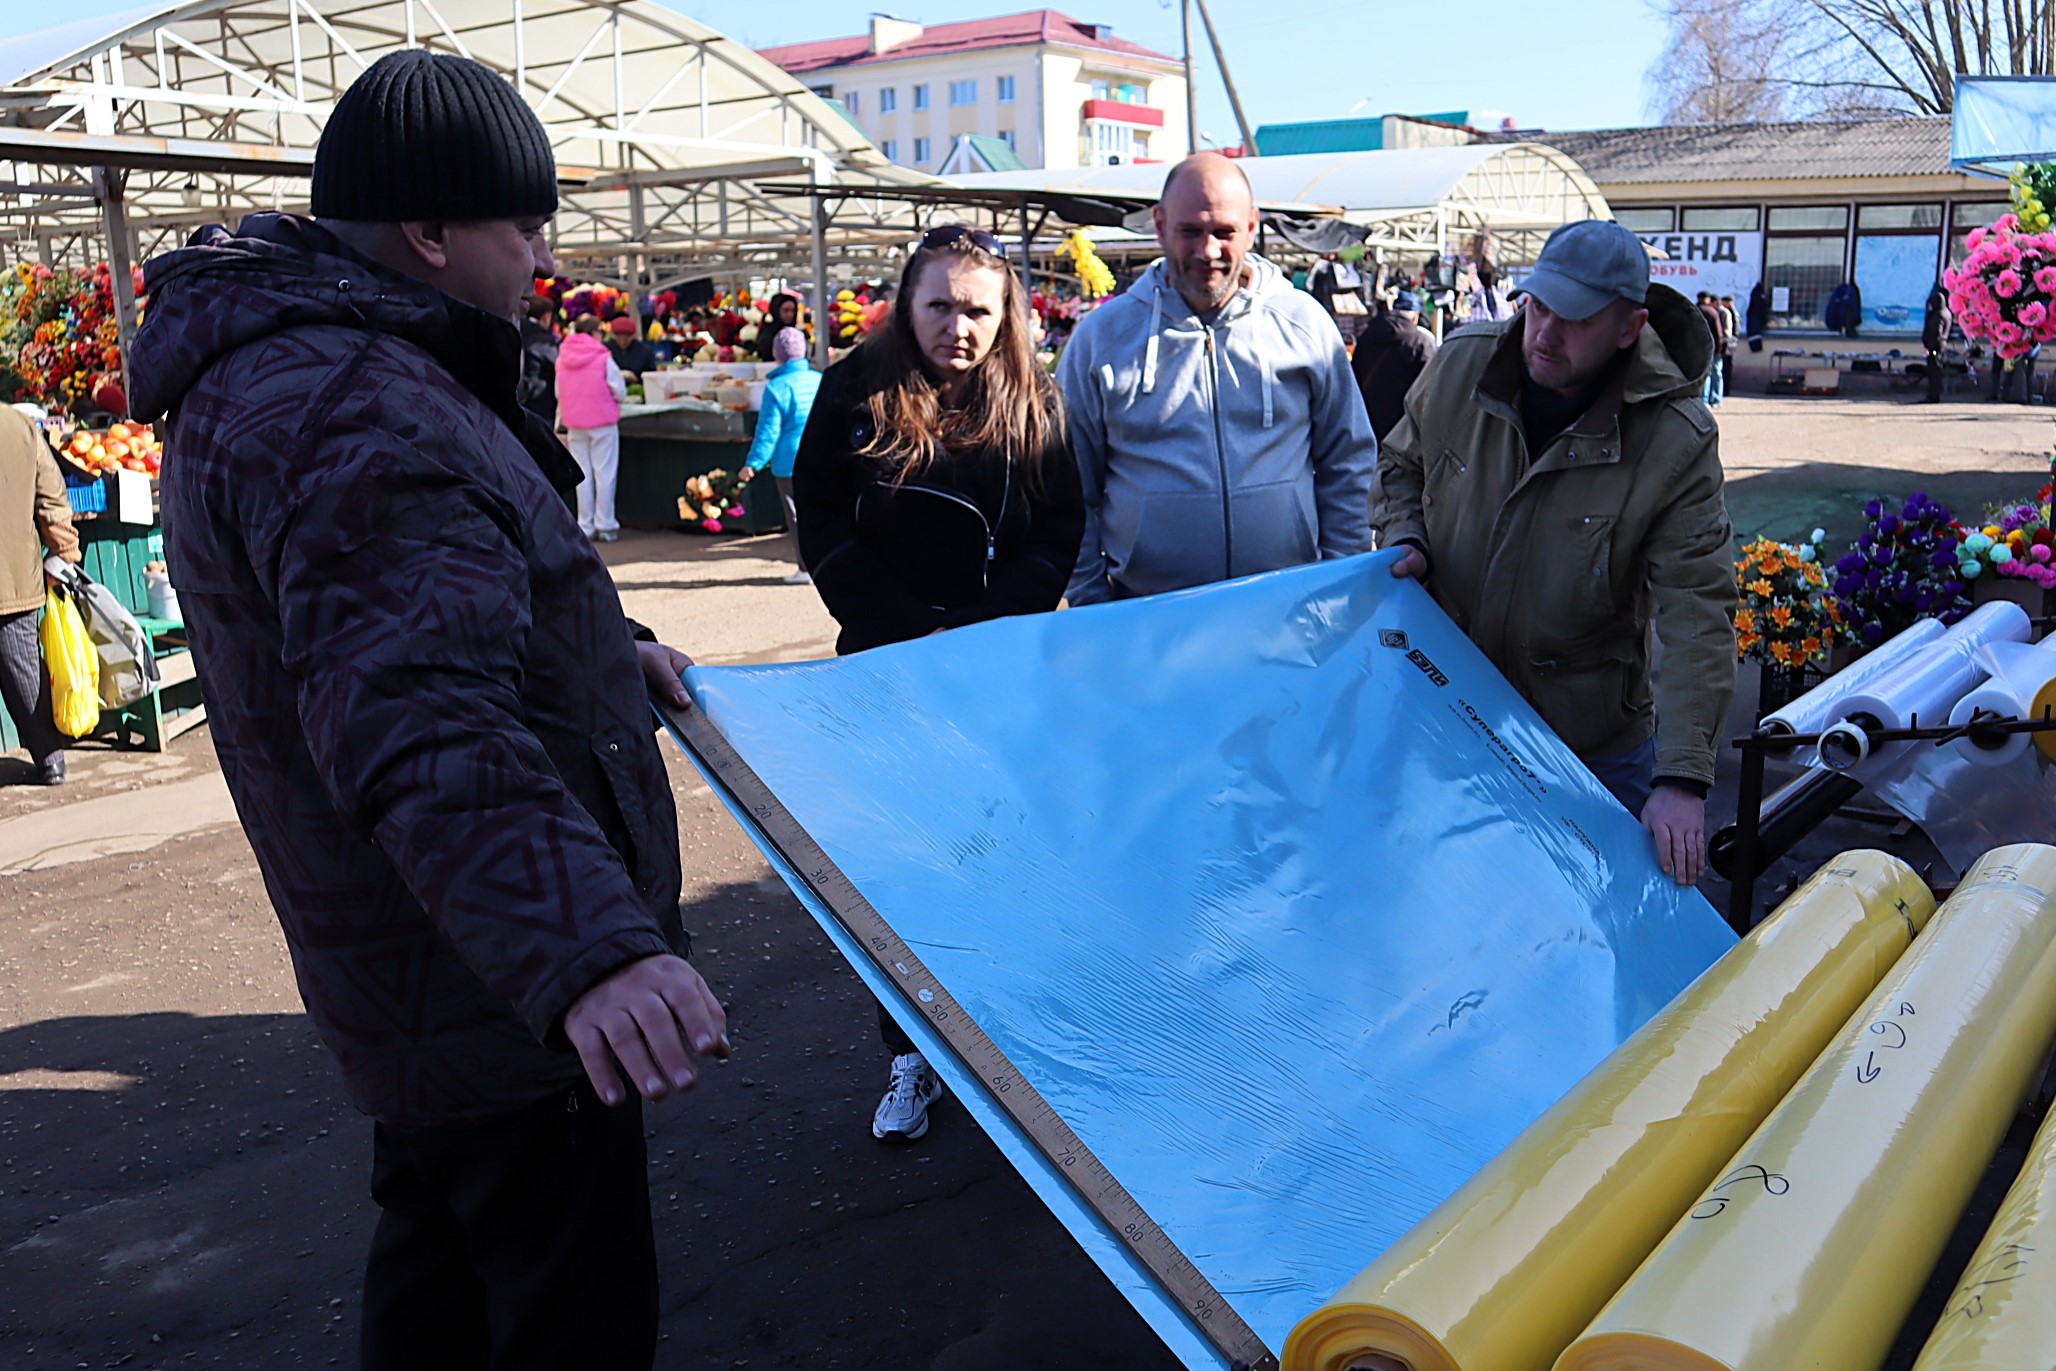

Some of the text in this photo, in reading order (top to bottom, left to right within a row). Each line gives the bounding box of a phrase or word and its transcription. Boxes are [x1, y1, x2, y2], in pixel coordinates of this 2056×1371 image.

[754, 804, 772, 819] 20
[811, 868, 828, 884] 30
[871, 937, 887, 952] 40
[930, 1004, 948, 1020] 50
[992, 1076, 1011, 1093] 60
[1057, 1147, 1076, 1167] 70
[1124, 1223, 1143, 1242] 80
[1195, 1300, 1212, 1319] 90
